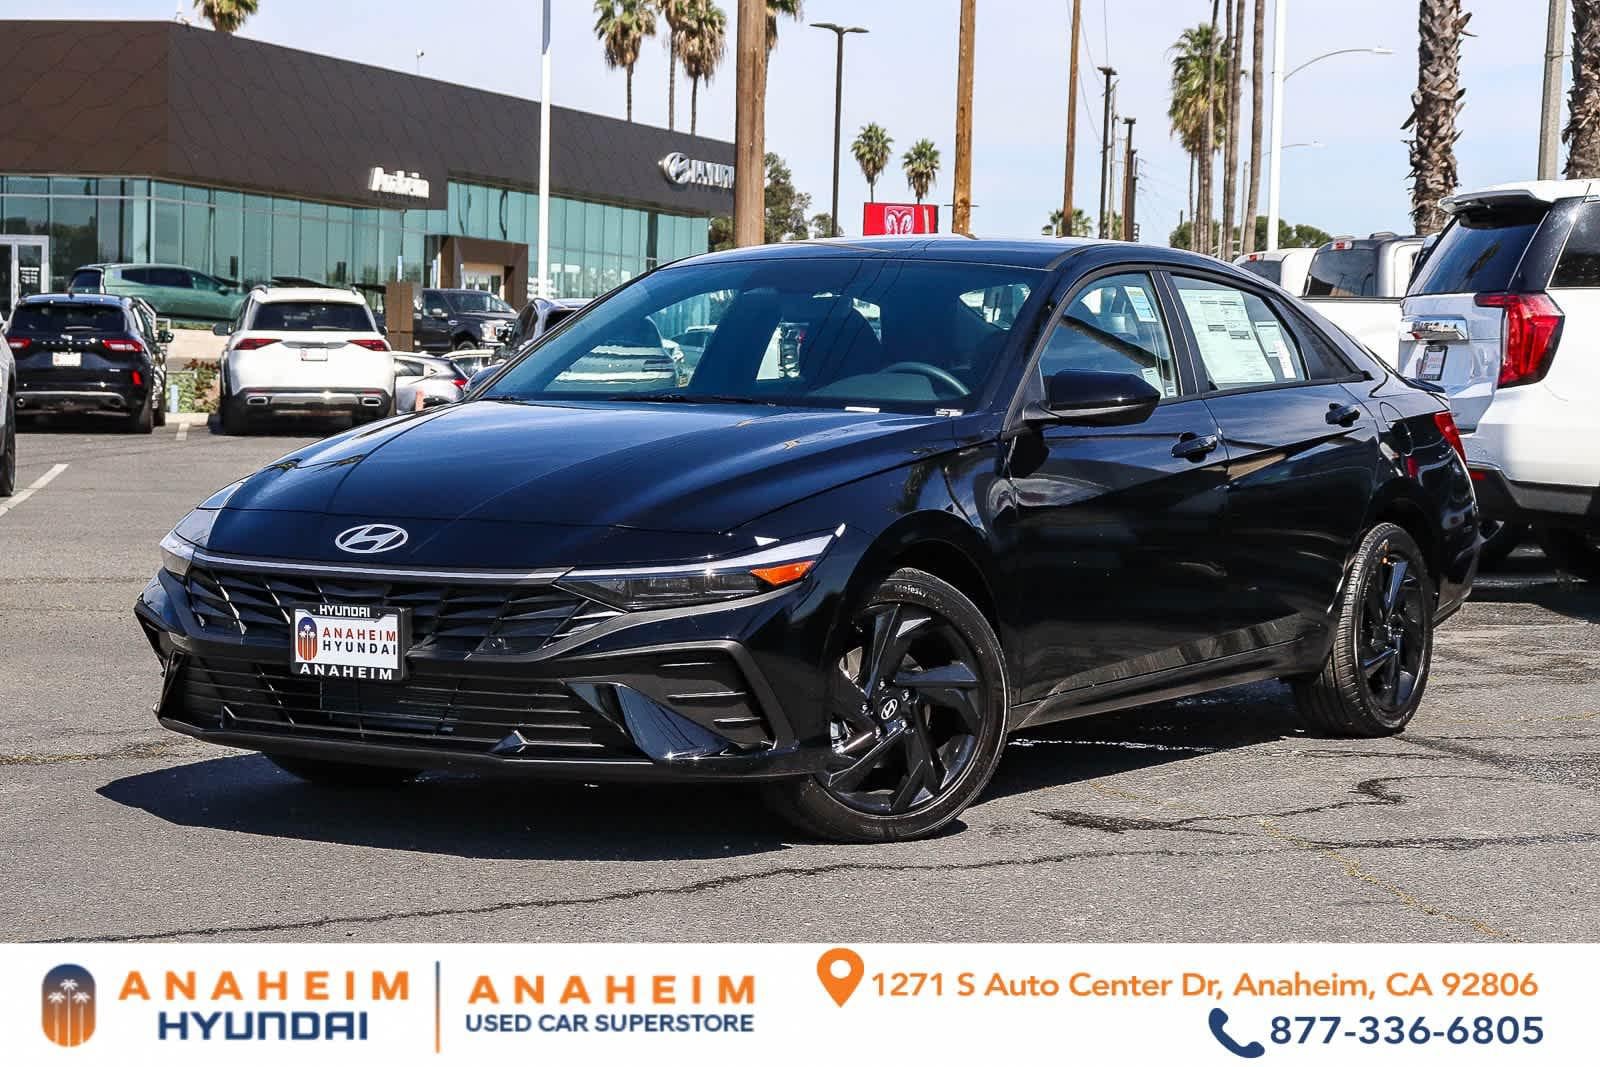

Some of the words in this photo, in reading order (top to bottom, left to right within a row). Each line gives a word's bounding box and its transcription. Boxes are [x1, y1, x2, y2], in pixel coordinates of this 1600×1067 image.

[319, 604, 370, 618] HYUNDAI
[322, 627, 396, 642] ANAHEIM
[322, 640, 396, 655] HYUNDAI
[300, 663, 393, 680] ANAHEIM
